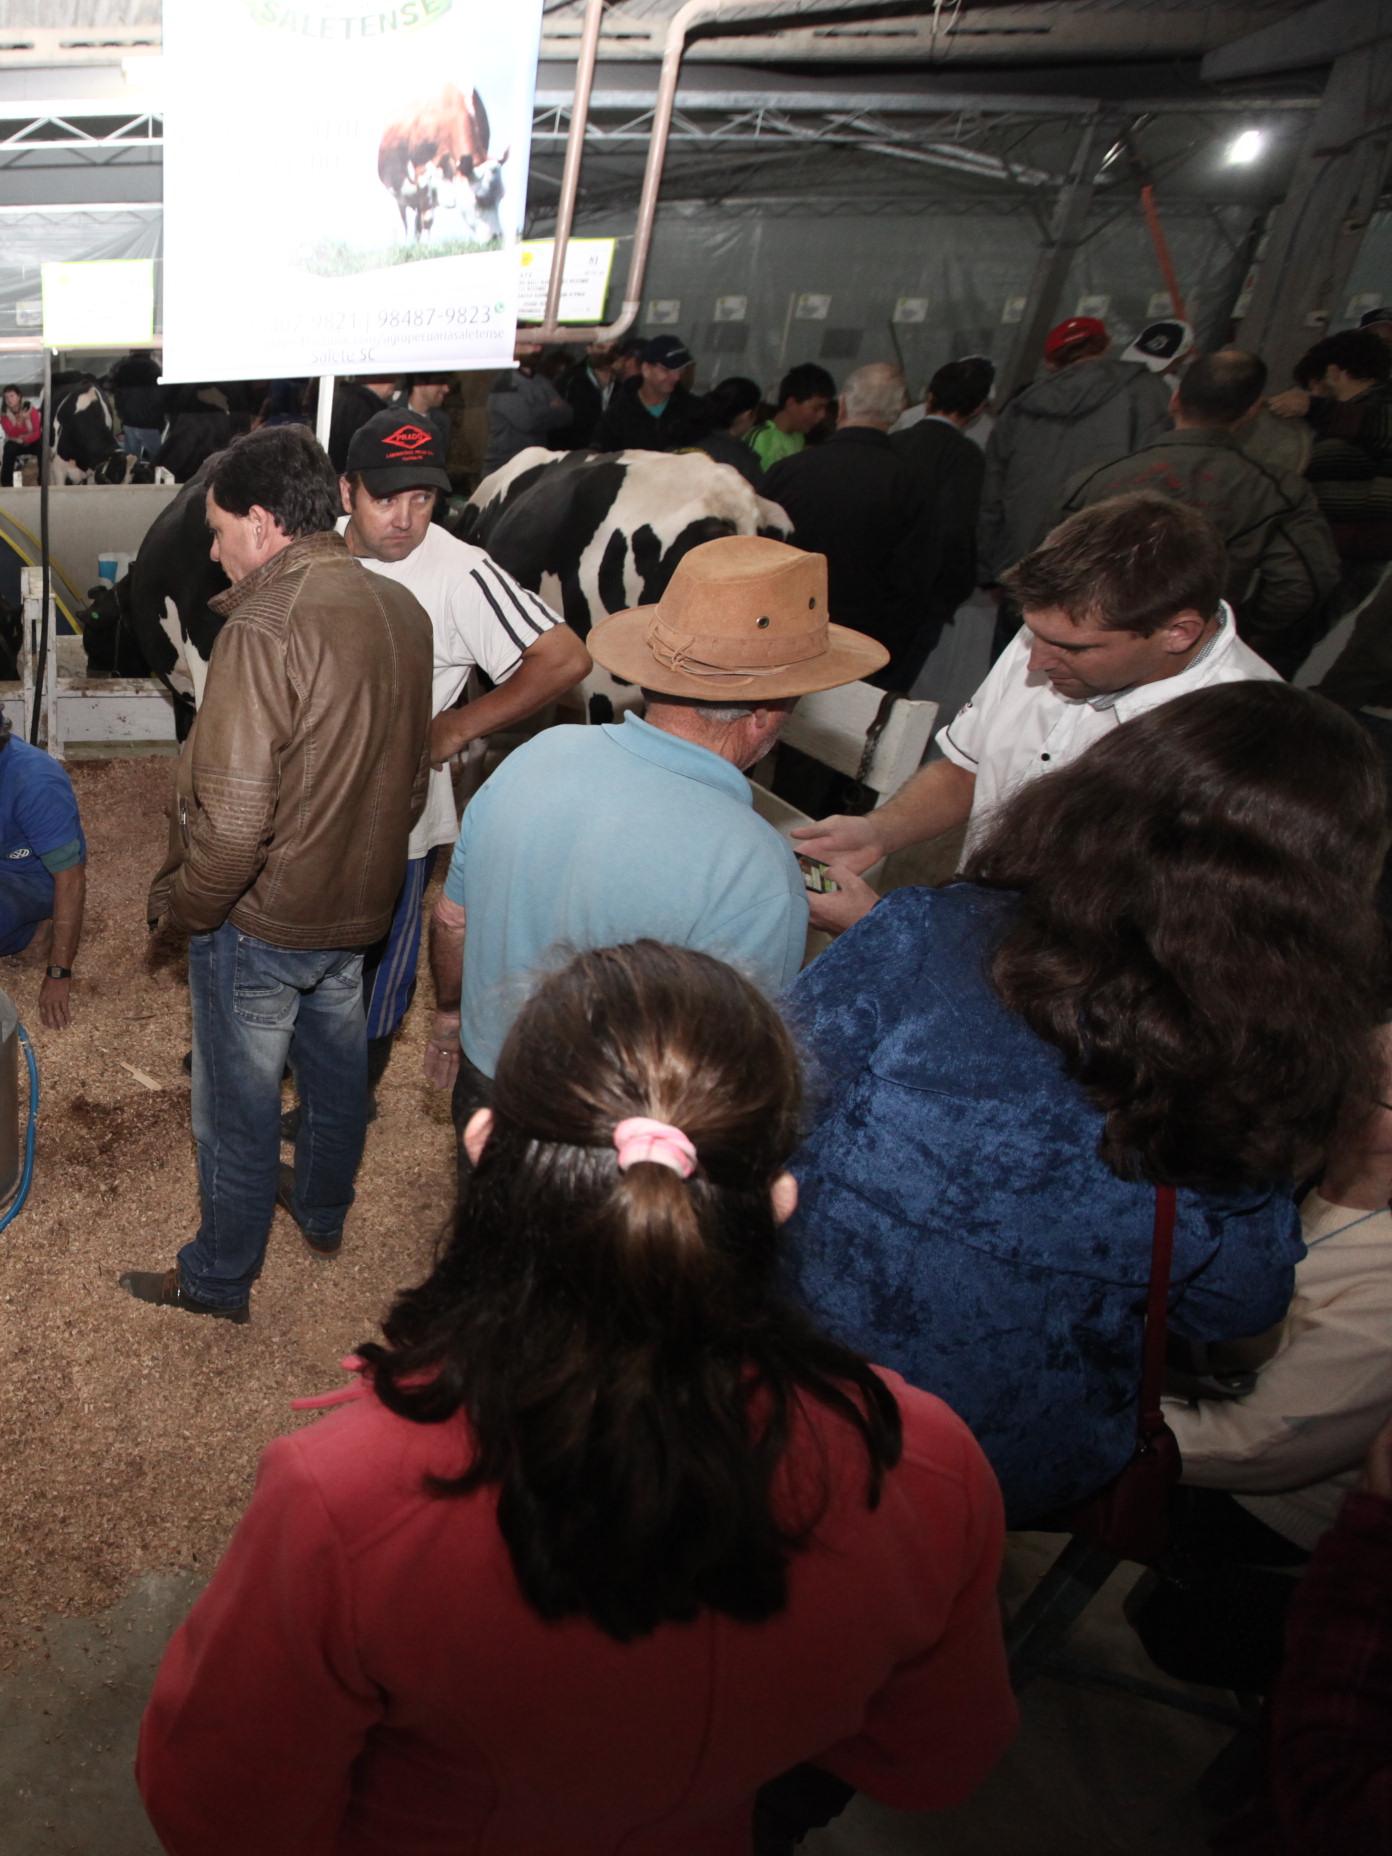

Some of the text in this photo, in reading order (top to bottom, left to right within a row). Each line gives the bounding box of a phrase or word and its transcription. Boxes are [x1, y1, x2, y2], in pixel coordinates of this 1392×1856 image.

[260, 0, 444, 41] SALETENSE
[377, 305, 491, 328] 98487-9823
[359, 346, 377, 361] SC
[396, 432, 423, 441] PRADO
